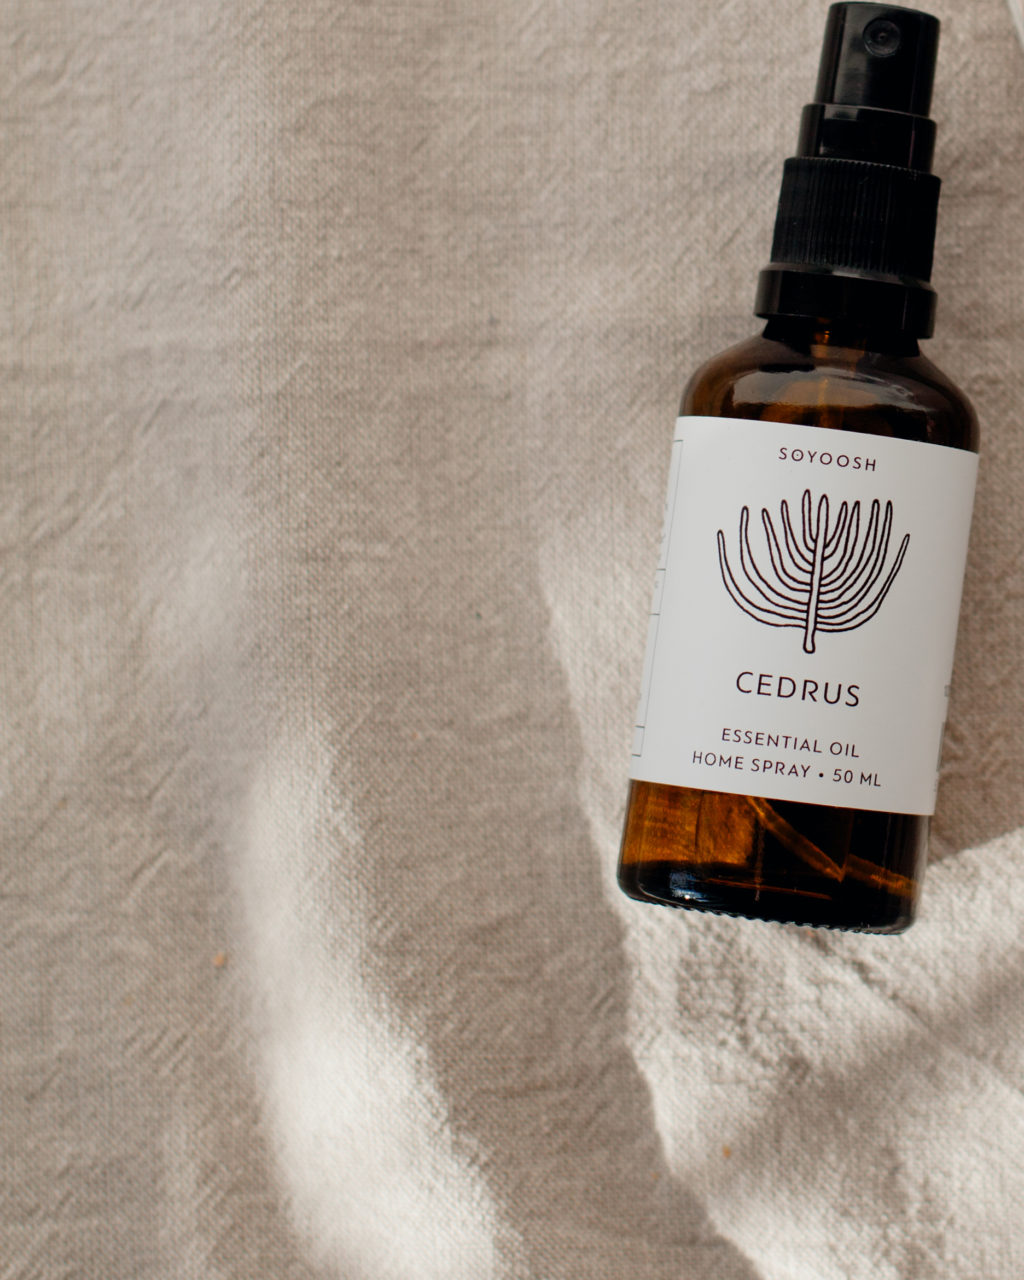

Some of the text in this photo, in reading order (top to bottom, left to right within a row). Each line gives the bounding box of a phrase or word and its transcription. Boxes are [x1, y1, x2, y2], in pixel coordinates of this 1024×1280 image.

[778, 446, 877, 472] SOYOOSH
[735, 670, 862, 708] CEDRUS
[721, 727, 860, 758] ESSENTIAL OIL
[692, 750, 882, 788] HOME SPRAY 50 ML
